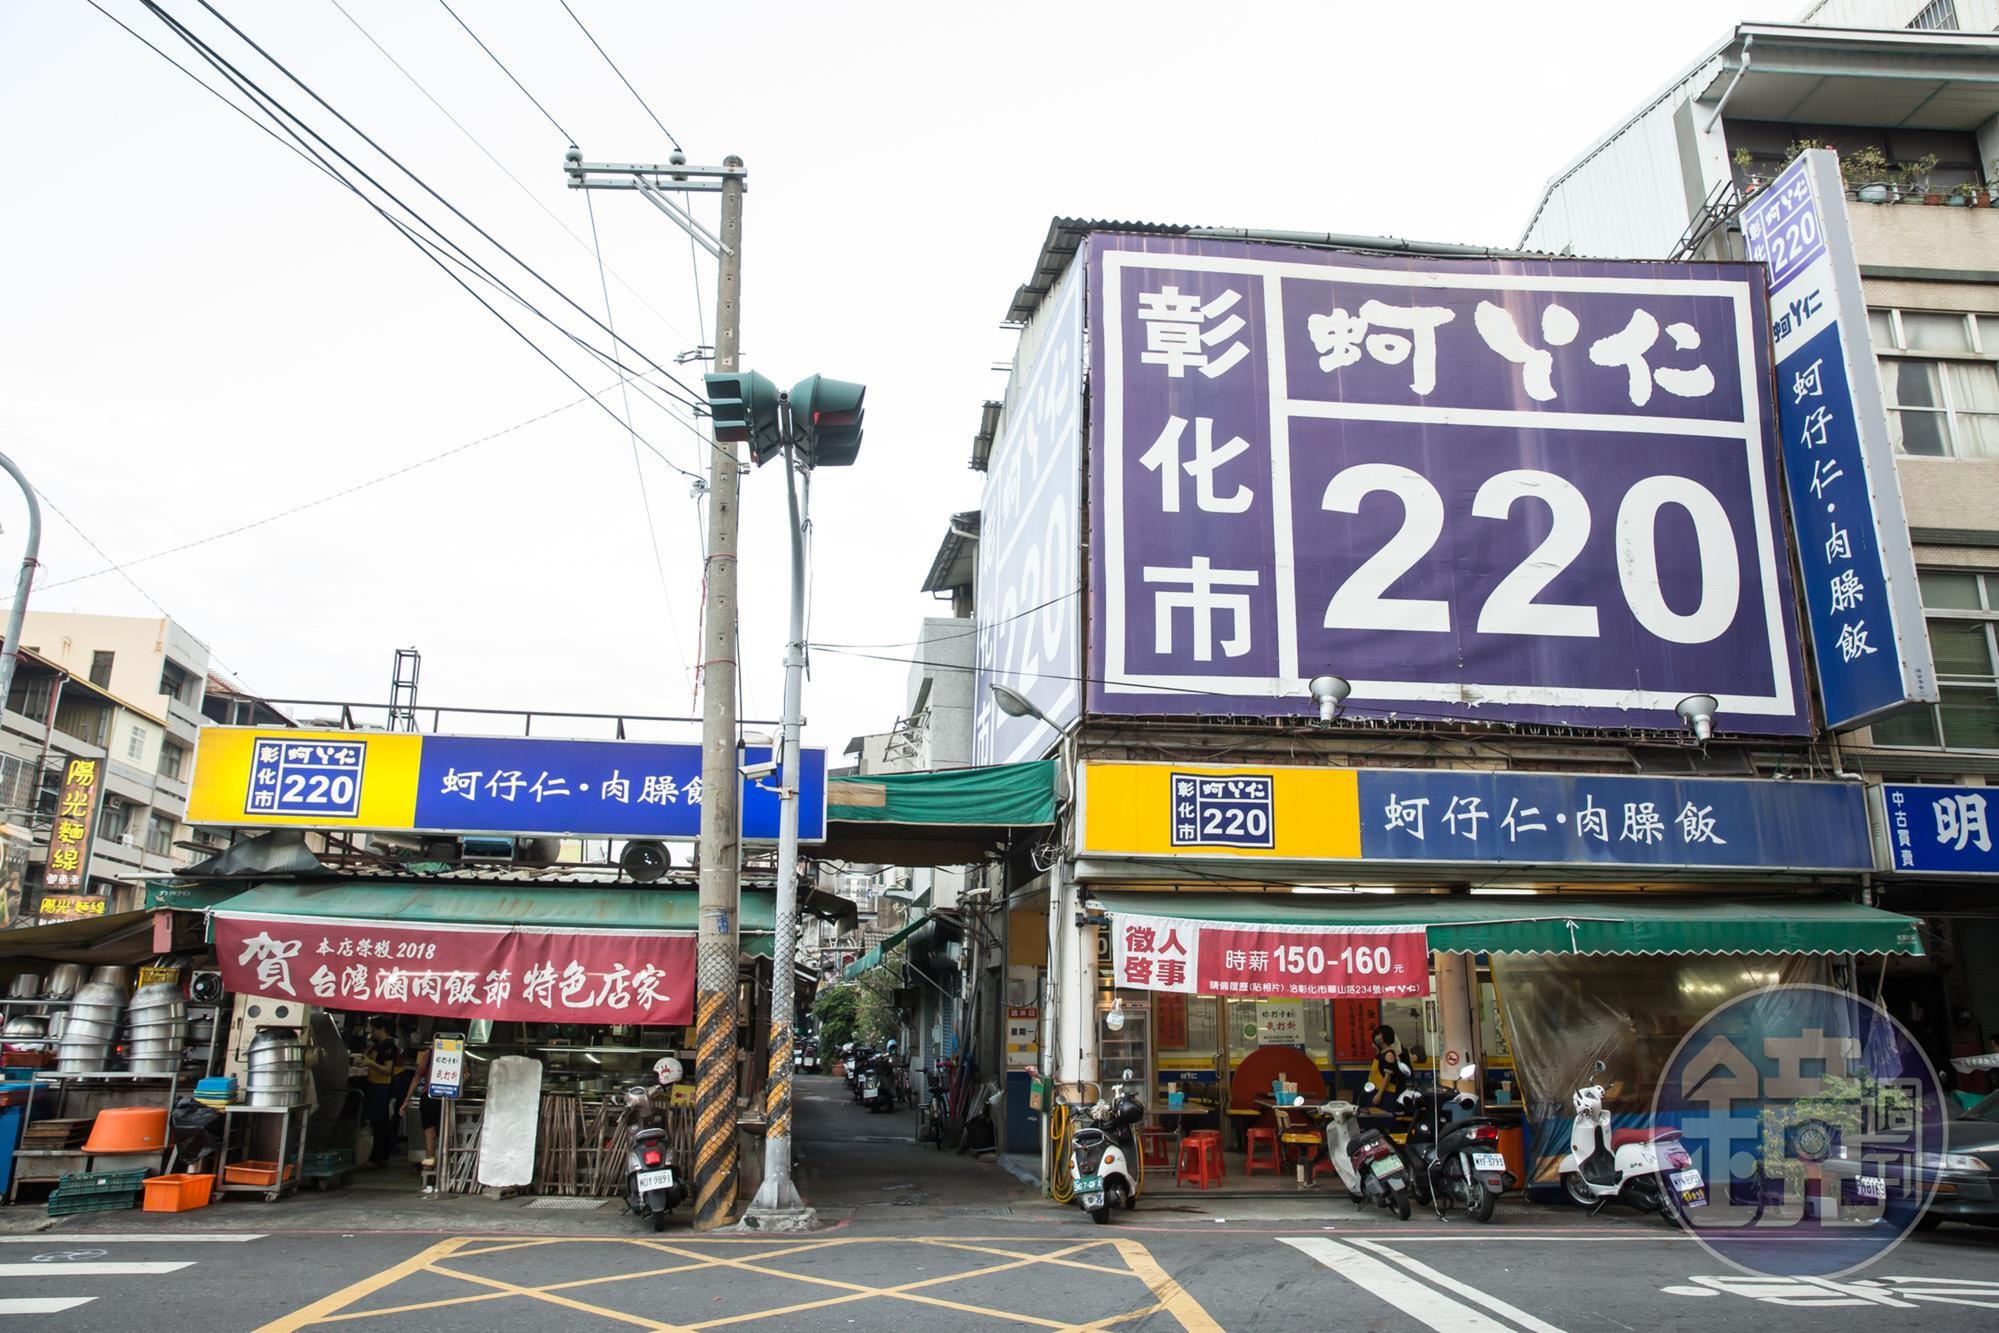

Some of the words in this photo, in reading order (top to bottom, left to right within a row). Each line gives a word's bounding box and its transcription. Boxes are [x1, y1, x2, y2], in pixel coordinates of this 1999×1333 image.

[1749, 218, 1767, 262] 彰化
[1771, 210, 1816, 274] 220
[1138, 285, 1260, 662] 彰化市
[1321, 462, 1740, 645] 220
[255, 746, 280, 807] 彰化市
[282, 774, 354, 804] 220
[51, 760, 96, 871] 陽光麵線
[1177, 781, 1196, 840] 彰化市
[1203, 807, 1267, 836] 220
[1892, 791, 1915, 867] 中古買賣
[1932, 793, 1992, 852] 明
[238, 931, 303, 997] 賀
[315, 937, 394, 960] 本店榮獲
[395, 942, 437, 960] 2018
[1125, 925, 1188, 956] 徵人
[522, 959, 671, 1010] 特色店家
